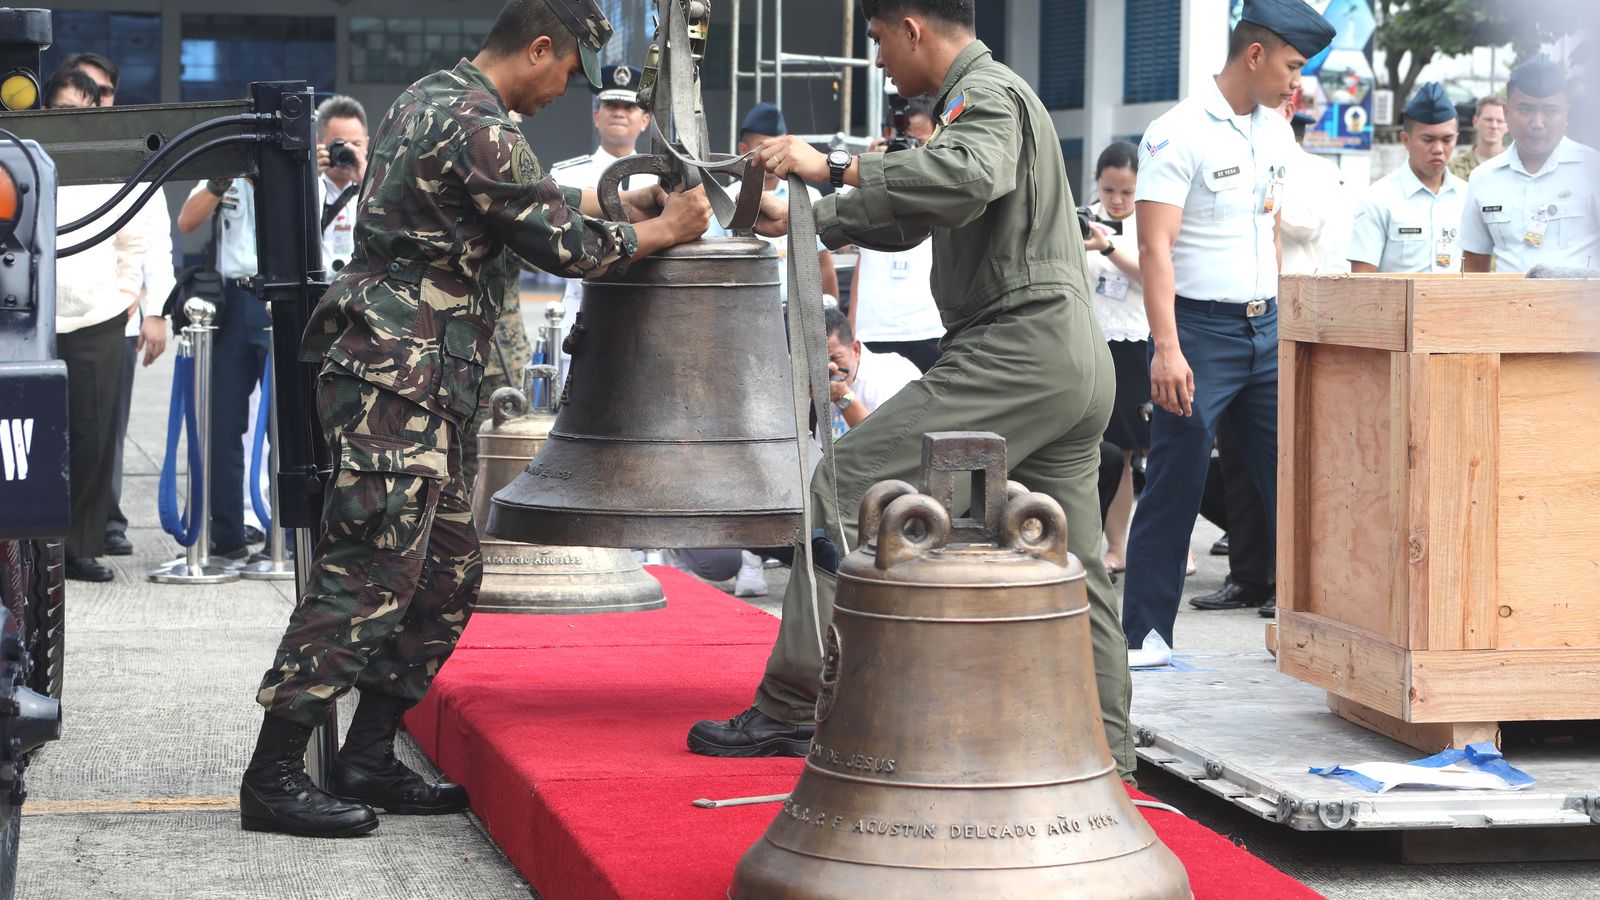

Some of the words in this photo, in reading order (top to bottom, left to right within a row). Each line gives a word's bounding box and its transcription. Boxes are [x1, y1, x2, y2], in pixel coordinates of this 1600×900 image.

[846, 754, 896, 773] JESUS
[852, 818, 938, 840] AGUSTIN
[950, 823, 1038, 839] DELGADO
[1048, 815, 1081, 836] AÑO
